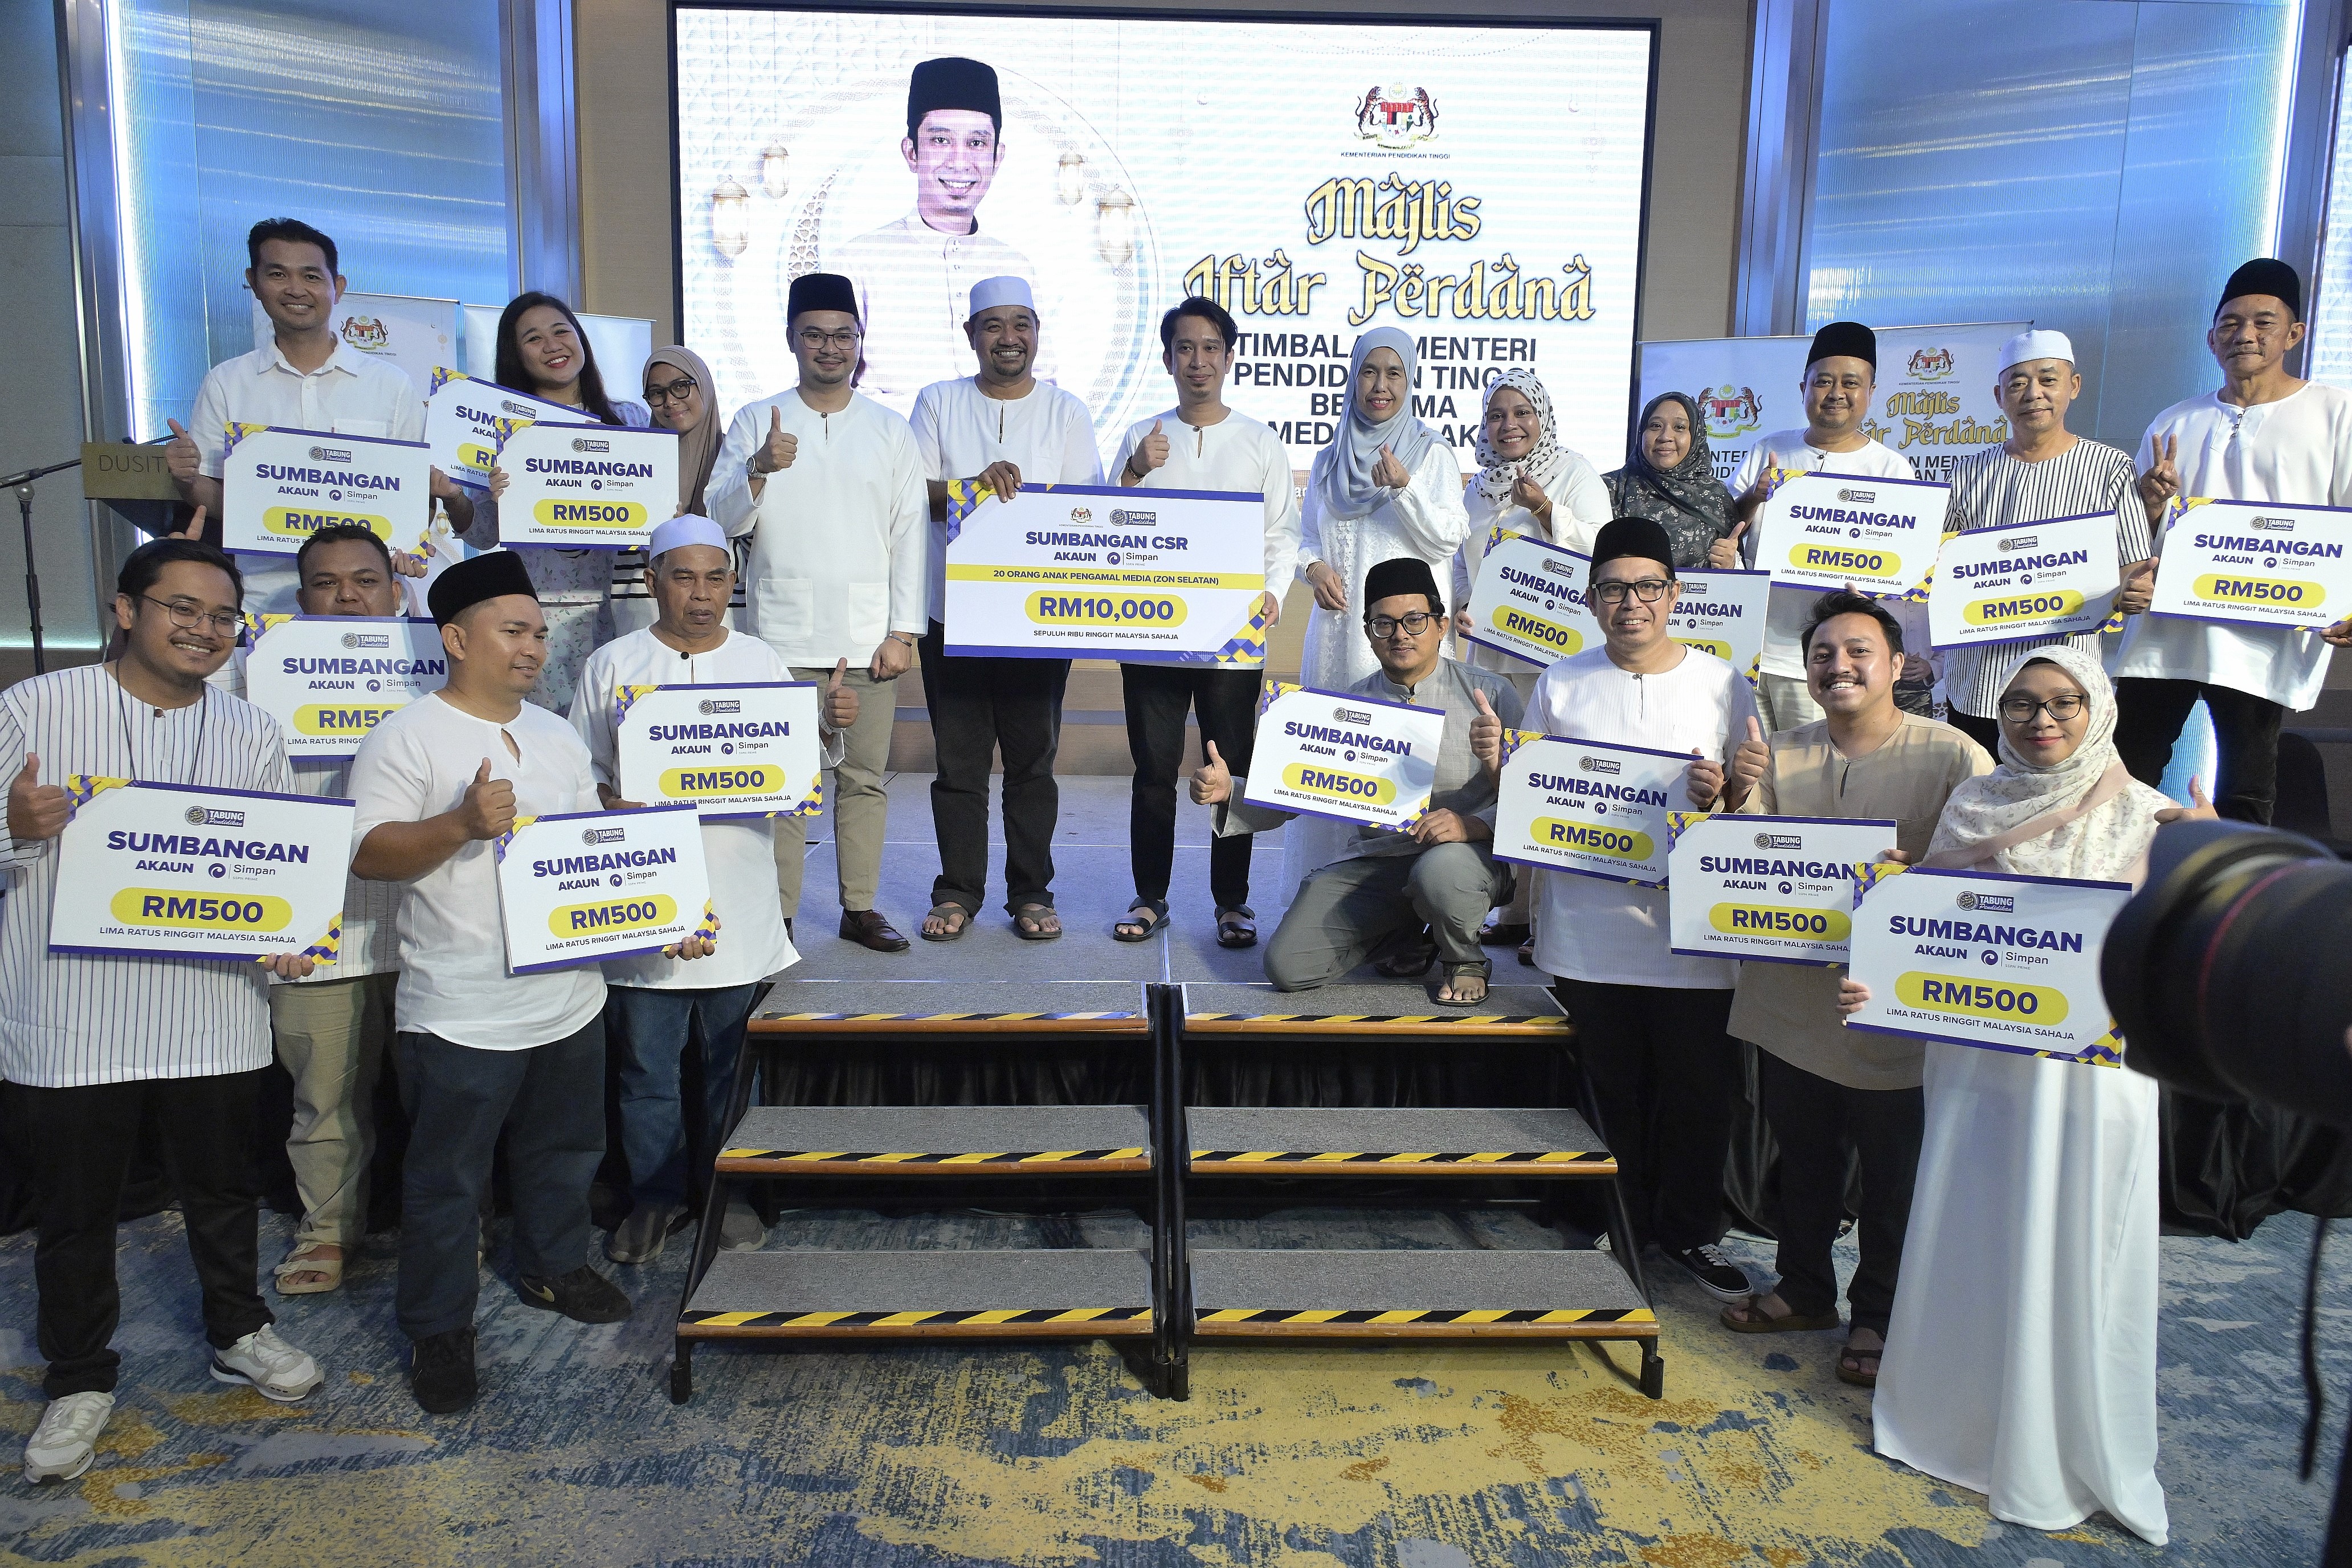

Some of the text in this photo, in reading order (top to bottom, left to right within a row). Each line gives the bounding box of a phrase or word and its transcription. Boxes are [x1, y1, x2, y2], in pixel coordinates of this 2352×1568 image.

[1237, 333, 1363, 358] TIMBAL
[99, 455, 170, 473] DUSIT
[467, 468, 487, 477] RATUS
[526, 458, 652, 477] SUMBANGAN
[256, 464, 399, 491] SUMBANGAN
[545, 479, 582, 487] AKAUN
[277, 486, 377, 500] AKAUN Simpan
[553, 504, 629, 522] RM500
[1790, 505, 1916, 529] SUMBANGAN
[1805, 525, 1840, 534] AKAUN
[1026, 531, 1188, 550] SUMBANGAN CSR
[2194, 534, 2343, 558] SUMBANGAN
[1054, 552, 1158, 562] AKAUN Simpan
[1807, 549, 1882, 570] RM500
[1953, 550, 2087, 579] SUMBANGAN
[2212, 555, 2253, 564] AKAUN
[1007, 570, 1040, 579] ORANG
[1070, 573, 1120, 582] PENGAMAL
[1122, 574, 1152, 582] MEDIA
[1153, 574, 1175, 584] (ZON
[1178, 576, 1219, 585] SELATAN)
[1973, 578, 2010, 589] AKAUN
[1500, 566, 1589, 609] SUMBANGA
[2214, 579, 2302, 601] RM500
[1040, 597, 1174, 622] RM10,000
[1510, 589, 1581, 615] AKAUN Simpan
[1983, 596, 2063, 619] RM500
[1506, 612, 1567, 646] RM500
[283, 658, 444, 675] SUMBANGAN
[387, 679, 420, 688] Simpan
[650, 722, 789, 741] SUMBANGAN
[1284, 721, 1411, 756] SUMBANGAN
[671, 745, 710, 754] AKAUN
[1300, 744, 1387, 762] AKAUN Simpan
[1596, 760, 1620, 769] TABUNG
[681, 770, 764, 790] RM500
[1301, 770, 1377, 797] RM500
[1528, 773, 1667, 807] SUMBANGAN
[210, 810, 243, 820] TABUNG
[1340, 801, 1370, 811] MALAYSIA
[1372, 807, 1396, 815] SAHAJA
[1546, 796, 1642, 815] AKAUN Simpan
[599, 829, 623, 838] TABUNG
[1550, 824, 1632, 852] RM500
[107, 831, 309, 863] SUMBANGAN
[135, 860, 275, 875] AKAUN Simpan
[533, 847, 676, 877] SUMBANGAN
[1700, 856, 1855, 880] SUMBANGAN
[558, 878, 599, 891] AKAUN
[1723, 880, 1832, 892] AKAUN Simpan
[142, 896, 263, 923] RM500
[1980, 896, 2012, 906] TABUNG
[571, 901, 656, 929] RM500
[1733, 909, 1827, 933] RM500
[207, 933, 255, 941] MALAYSIA
[566, 939, 589, 948] RATUS
[591, 934, 620, 944] RINGGIT
[622, 929, 657, 939] MALAYSIA
[659, 925, 685, 934] SAHAJA
[1889, 916, 2082, 953] SUMBANGAN
[1914, 945, 2048, 964] AKAUN Simpan
[1923, 980, 2037, 1014] RM500
[1911, 1011, 1939, 1021] RATUS
[1943, 1016, 1981, 1026] RINGGIT
[1984, 1022, 2031, 1034] MALAYSIA
[2035, 1028, 2074, 1040] SAHAJA
